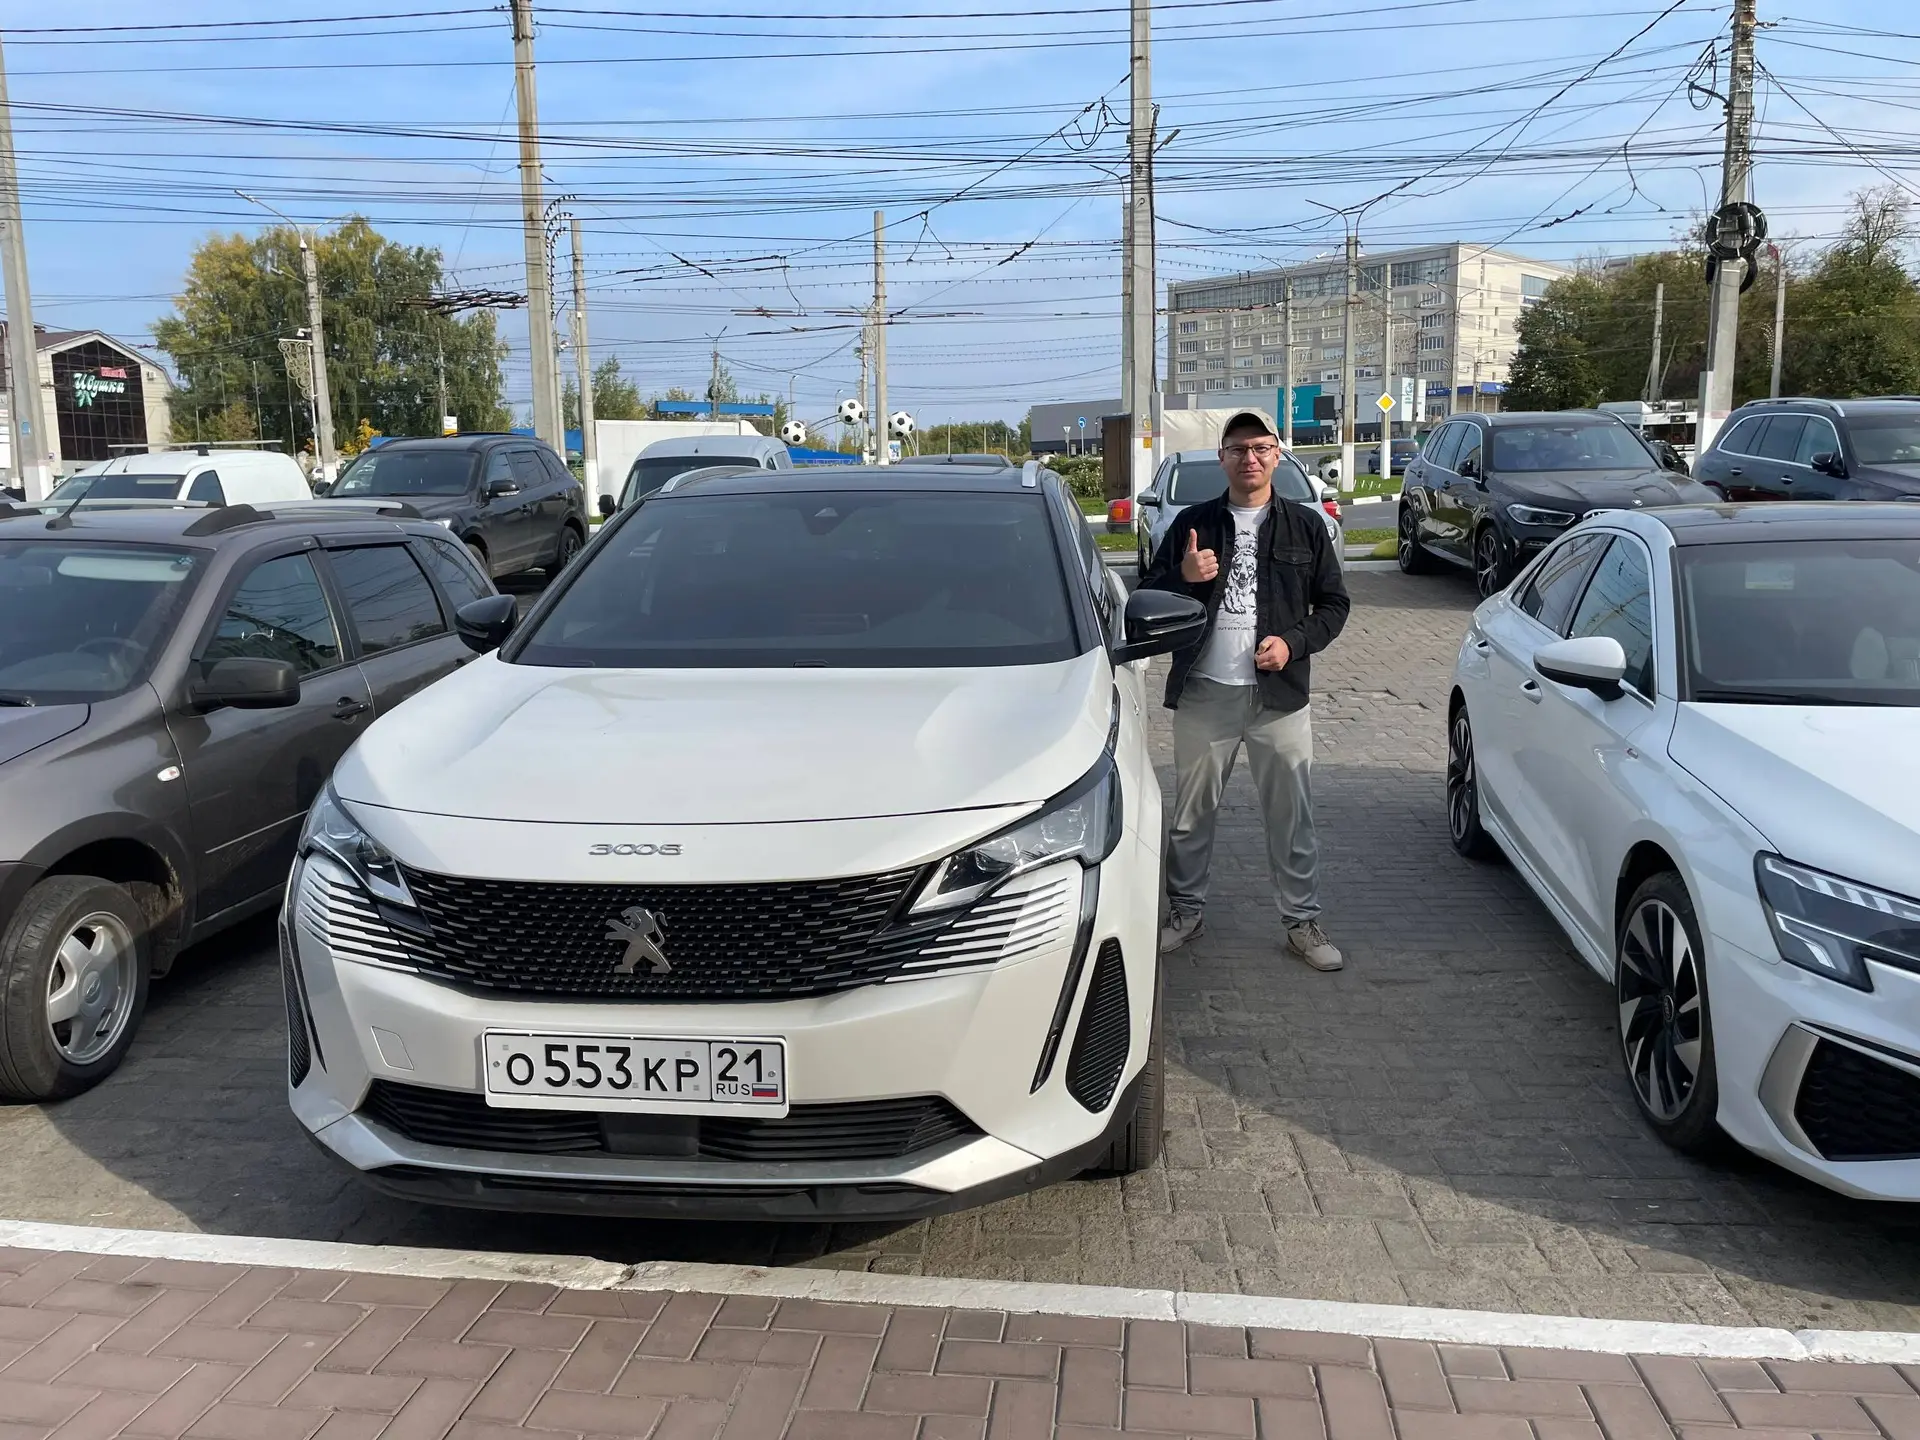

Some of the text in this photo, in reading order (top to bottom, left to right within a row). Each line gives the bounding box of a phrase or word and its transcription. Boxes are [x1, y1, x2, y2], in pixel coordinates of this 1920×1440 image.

[73, 372, 125, 398] Ивушка
[717, 1047, 763, 1083] 21
[716, 1083, 751, 1096] RUS
